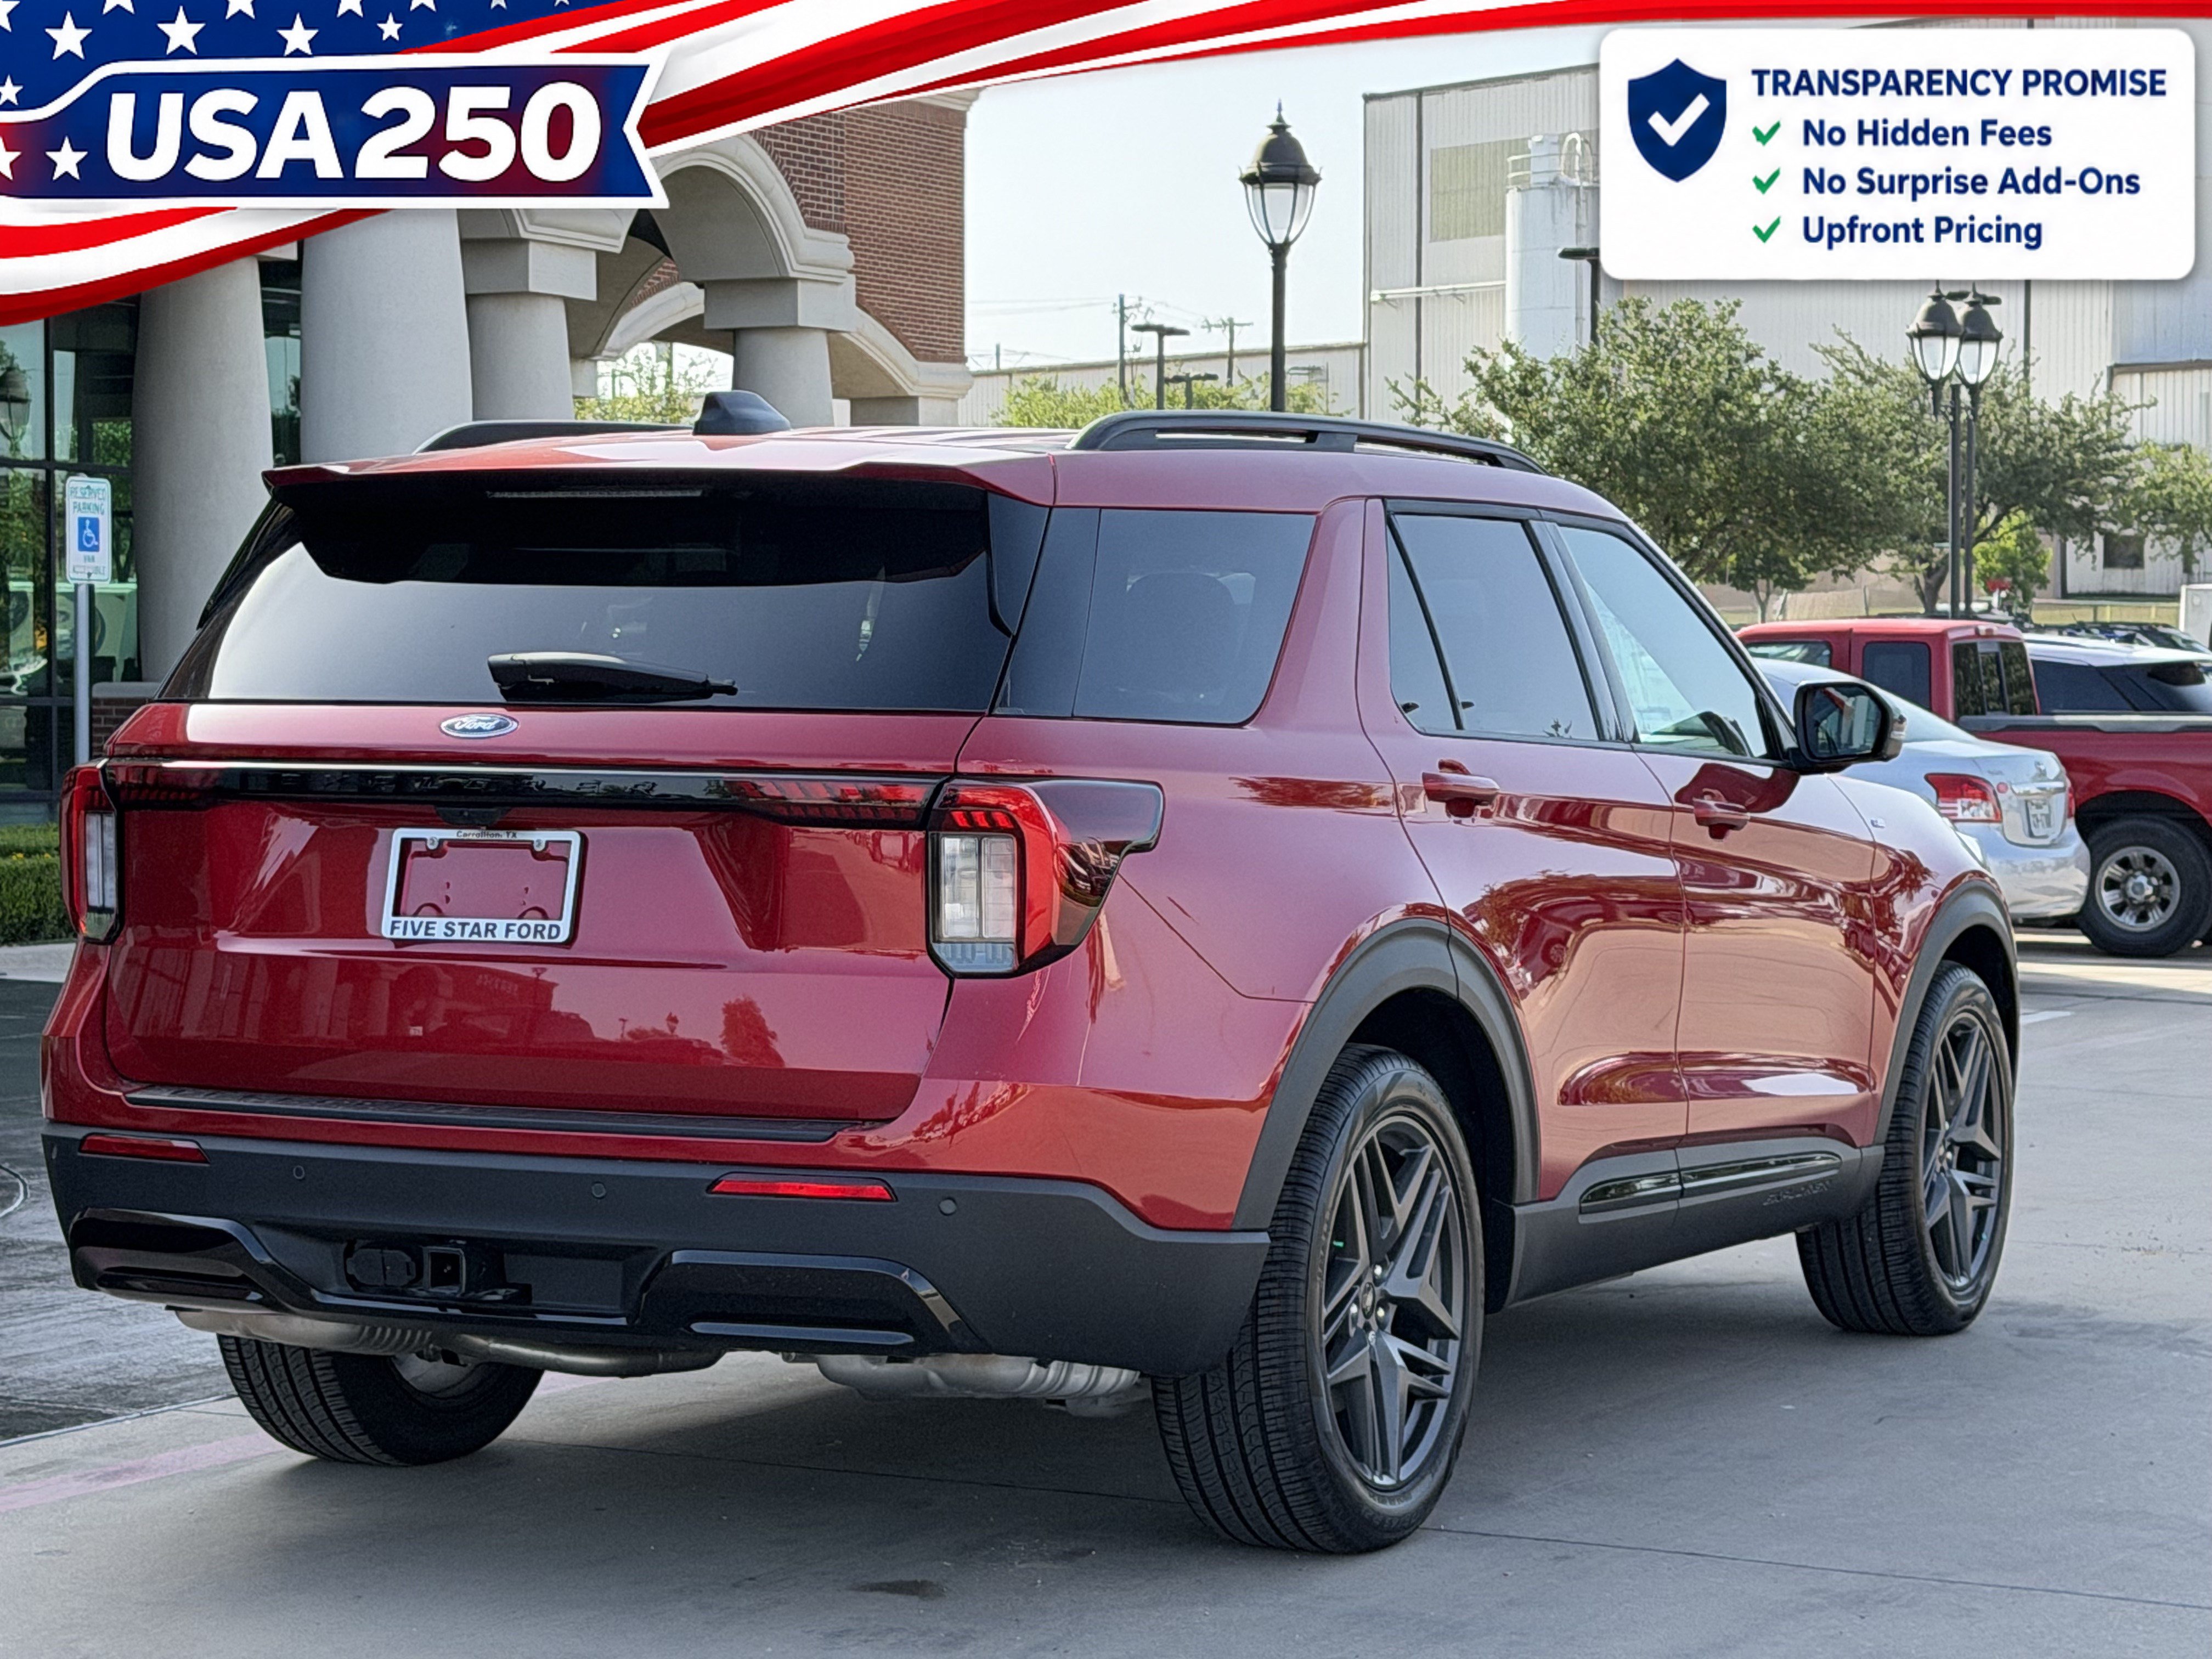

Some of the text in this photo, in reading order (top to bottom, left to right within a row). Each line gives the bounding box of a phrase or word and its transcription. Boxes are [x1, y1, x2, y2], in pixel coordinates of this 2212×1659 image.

[73, 501, 105, 515] PARKING
[505, 831, 517, 839] TX
[390, 920, 561, 940] FIVE STAR FORD
